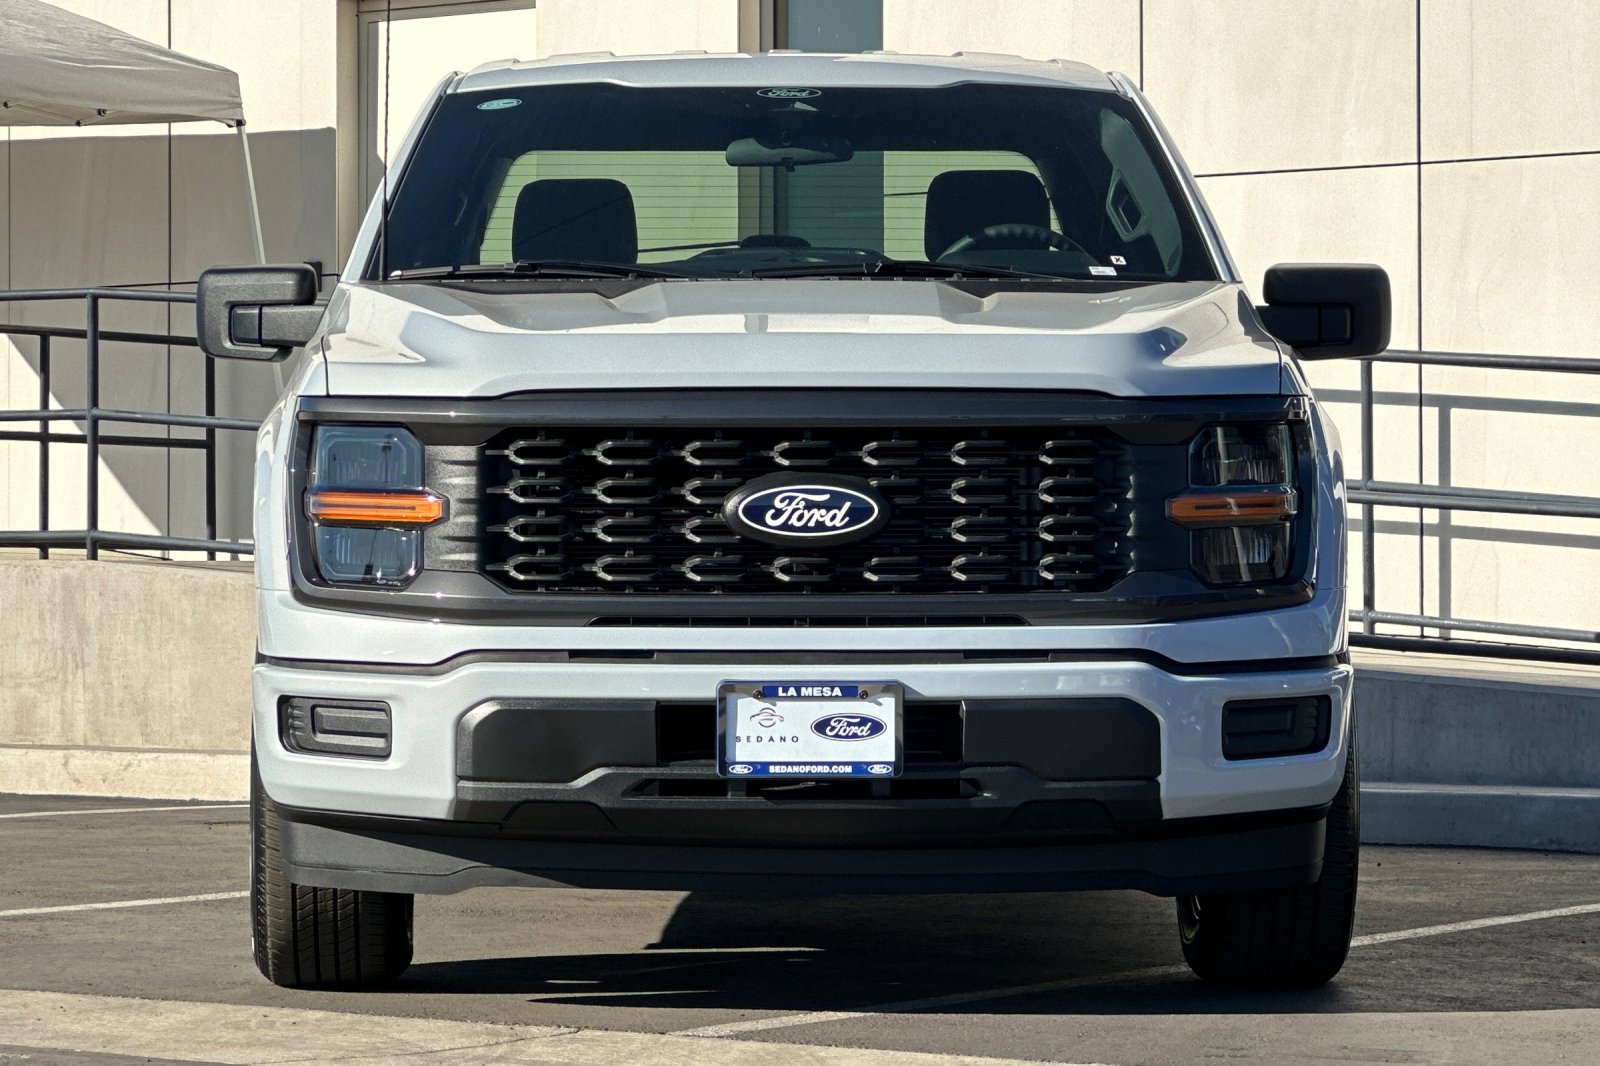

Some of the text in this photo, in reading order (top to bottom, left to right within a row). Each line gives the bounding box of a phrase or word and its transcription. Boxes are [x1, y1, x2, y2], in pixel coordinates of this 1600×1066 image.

[767, 88, 811, 97] Ford
[765, 492, 852, 527] Ford
[778, 687, 842, 697] LA MESA
[825, 717, 872, 736] Ford
[769, 765, 853, 773] SEDANOFORD.COM
